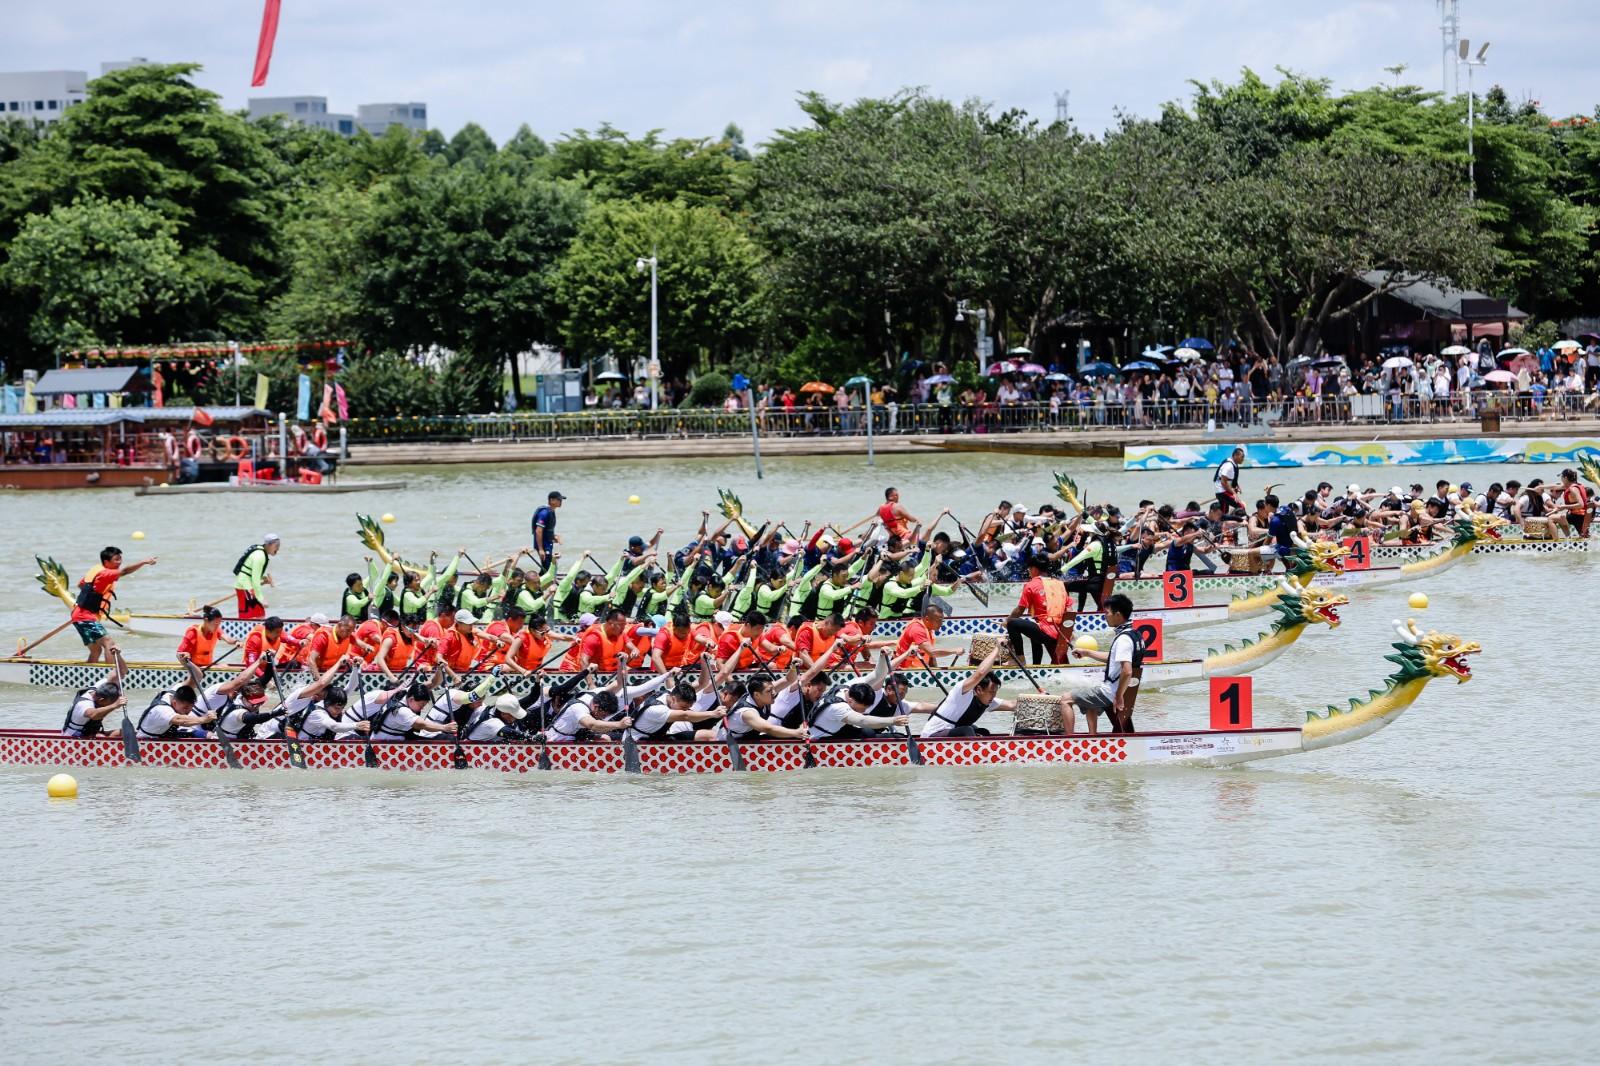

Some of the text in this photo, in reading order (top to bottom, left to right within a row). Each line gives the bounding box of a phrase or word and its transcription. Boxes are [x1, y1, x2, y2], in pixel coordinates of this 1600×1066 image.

[1349, 541, 1365, 564] 4
[1168, 573, 1188, 602] 3
[1136, 624, 1157, 658] 2
[1219, 683, 1240, 725] 1
